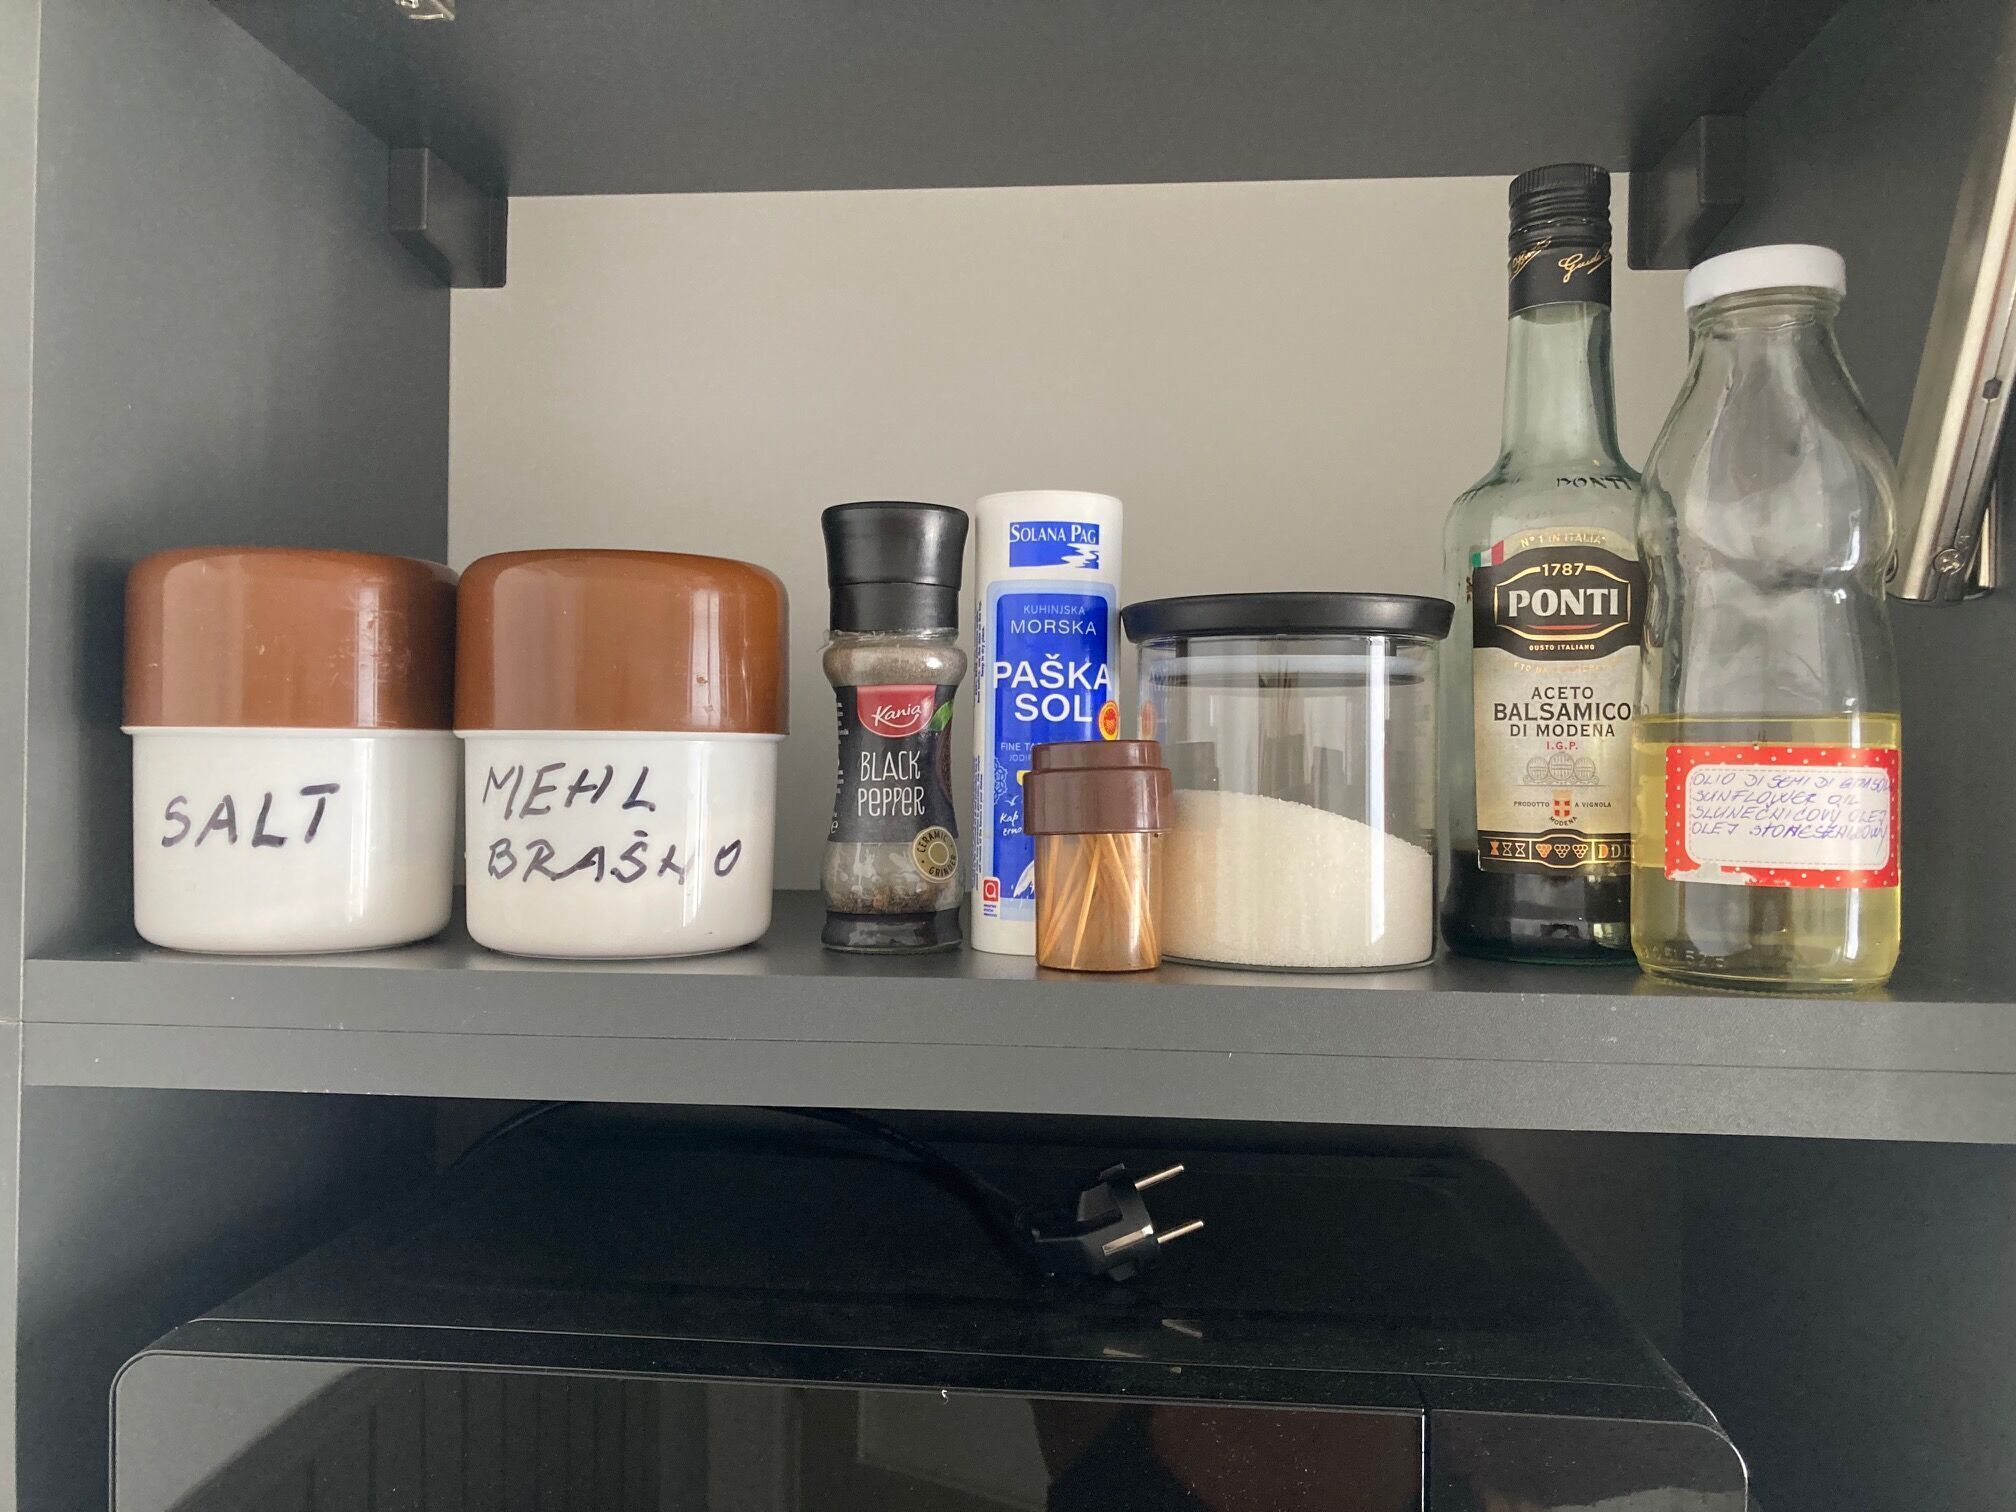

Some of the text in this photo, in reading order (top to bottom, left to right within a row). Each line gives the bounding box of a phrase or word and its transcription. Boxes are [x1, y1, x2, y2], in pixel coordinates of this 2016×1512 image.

[1557, 475, 1632, 490] PONTI
[1009, 524, 1096, 544] SOLANA PAG
[1541, 563, 1585, 577] 1787
[1023, 604, 1086, 616] KUHINJSKA
[1508, 588, 1619, 617] PONTI
[1010, 619, 1097, 636] MORSKA
[1528, 643, 1595, 652] GUSTO ITALIANO
[993, 653, 1113, 691] PAŠKA
[1531, 686, 1594, 699] ACETO
[872, 703, 921, 728] Kania
[1014, 693, 1093, 722] SOL
[1494, 703, 1631, 721] BALSAMICO
[1510, 724, 1615, 737] DI MODENA
[1000, 742, 1021, 751] FINE
[1546, 741, 1579, 750] I.G.P.
[861, 751, 921, 781] BLACK
[1693, 772, 1736, 786] OLIO
[1744, 774, 1765, 787] DI
[1814, 776, 1835, 788] DI
[482, 762, 656, 820] MEHL
[1692, 789, 1859, 805] SUNFLOWER OIL
[161, 783, 340, 848] SALT
[1549, 815, 1578, 827] MODENA
[1692, 820, 1739, 835] OLEJ
[917, 830, 949, 853] CERAMIC
[928, 854, 956, 877] GRINDER
